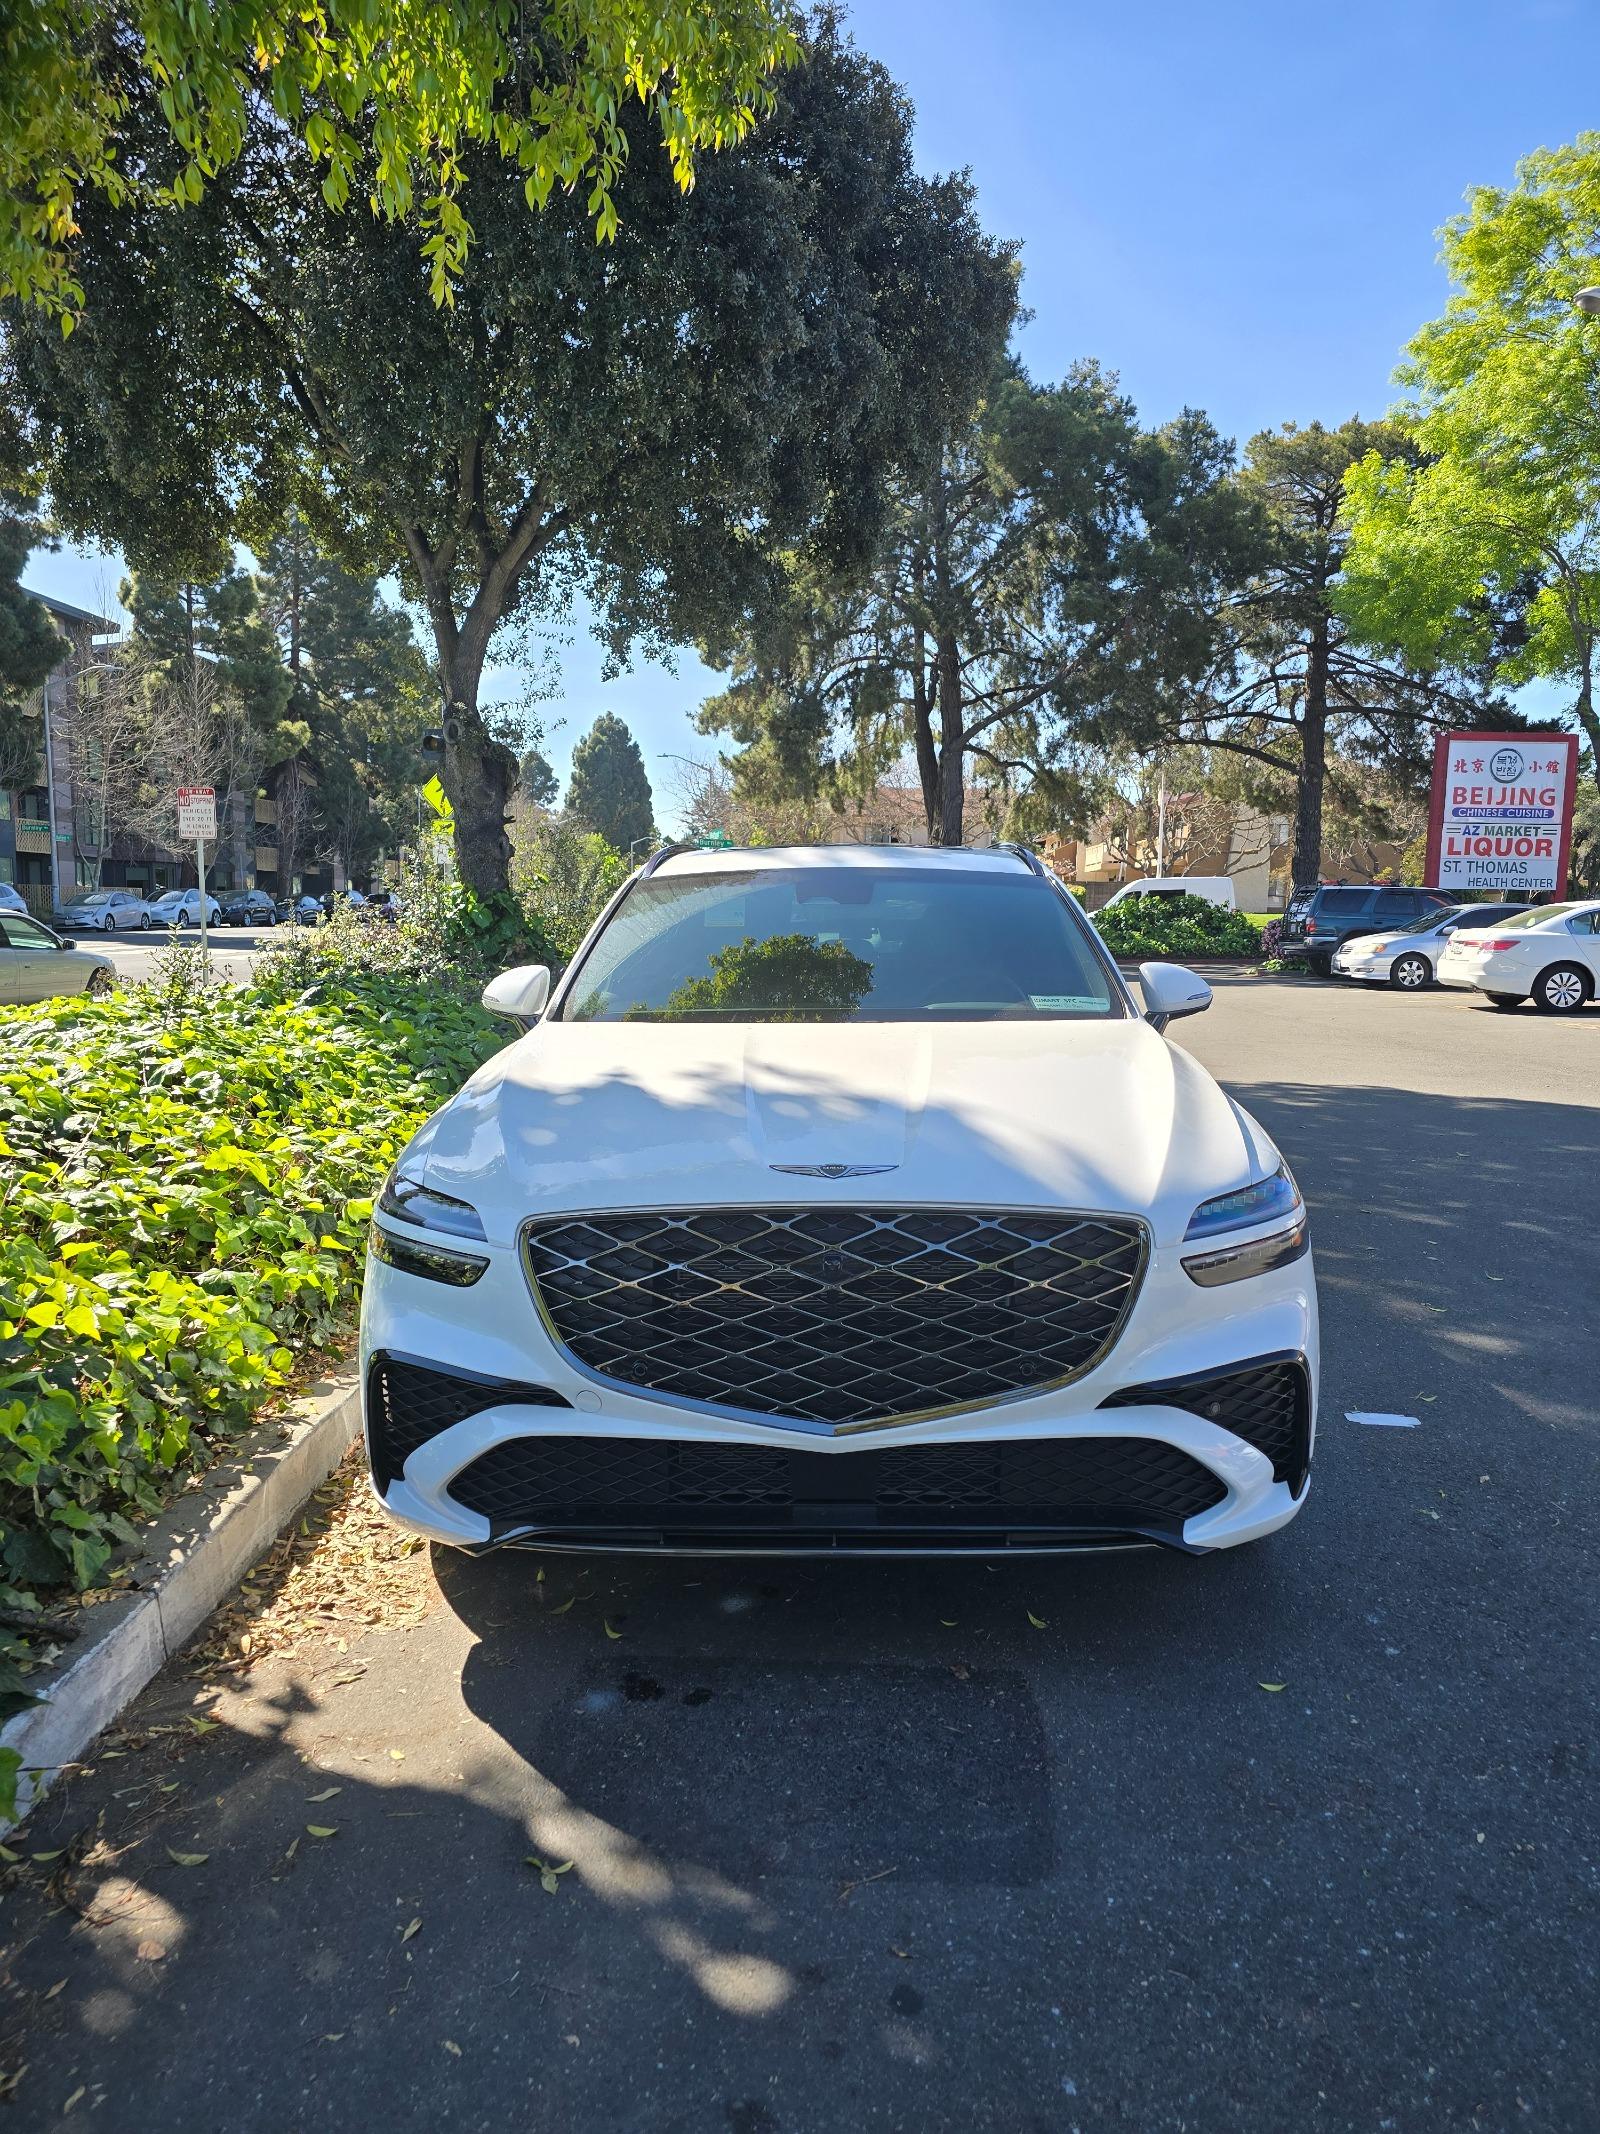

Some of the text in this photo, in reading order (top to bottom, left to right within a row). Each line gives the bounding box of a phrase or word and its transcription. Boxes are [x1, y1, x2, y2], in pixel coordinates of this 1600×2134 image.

[1454, 758, 1485, 774] 北京
[180, 795, 190, 806] NO
[1452, 786, 1556, 807] BEIJING
[1458, 808, 1549, 818] CHINESE CUISINE
[1462, 825, 1541, 837] AZ MARKET
[700, 840, 725, 848] Burnley
[1446, 837, 1553, 857] LIQUOR
[1443, 860, 1528, 874] ST. THOMAS
[1467, 877, 1553, 888] HEALTH CENTER
